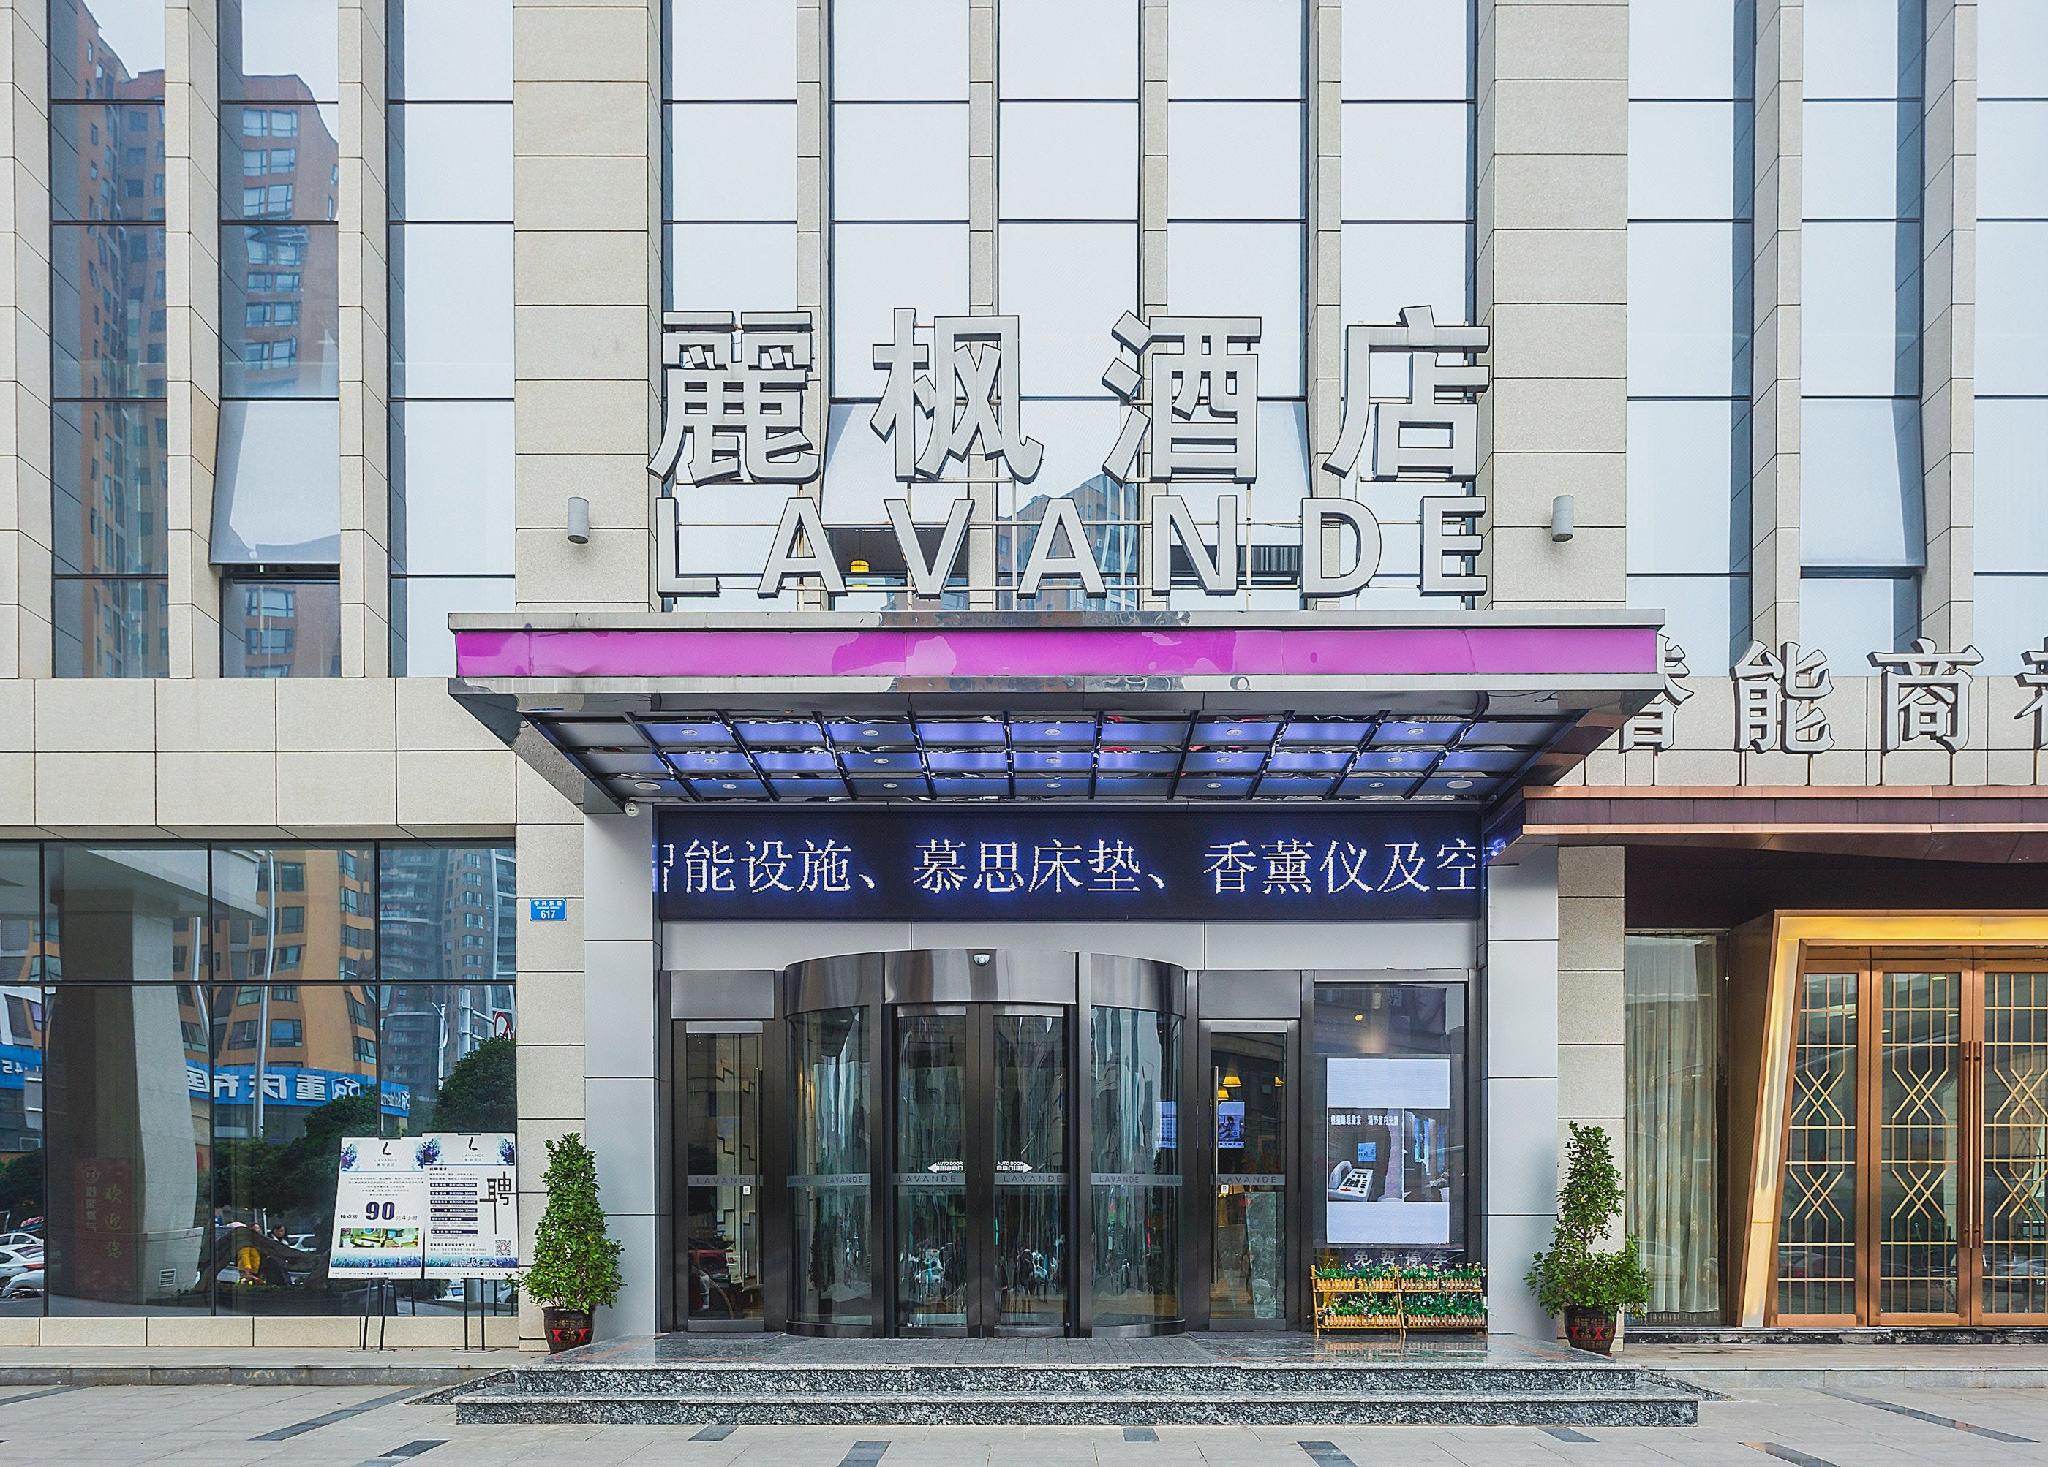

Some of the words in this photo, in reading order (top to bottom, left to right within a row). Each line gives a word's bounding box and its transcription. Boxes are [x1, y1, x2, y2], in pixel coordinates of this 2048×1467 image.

[648, 306, 1491, 484] 麗枫酒店
[656, 496, 1488, 599] LAVANDE
[540, 910, 556, 919] 617
[898, 1174, 957, 1183] LAVANDE
[1002, 1174, 1063, 1183] LAVANDE
[1099, 1175, 1140, 1184] LAVANDE
[1219, 1175, 1277, 1184] LAVANDE
[480, 1171, 516, 1234] 聘
[365, 1201, 396, 1221] 90
